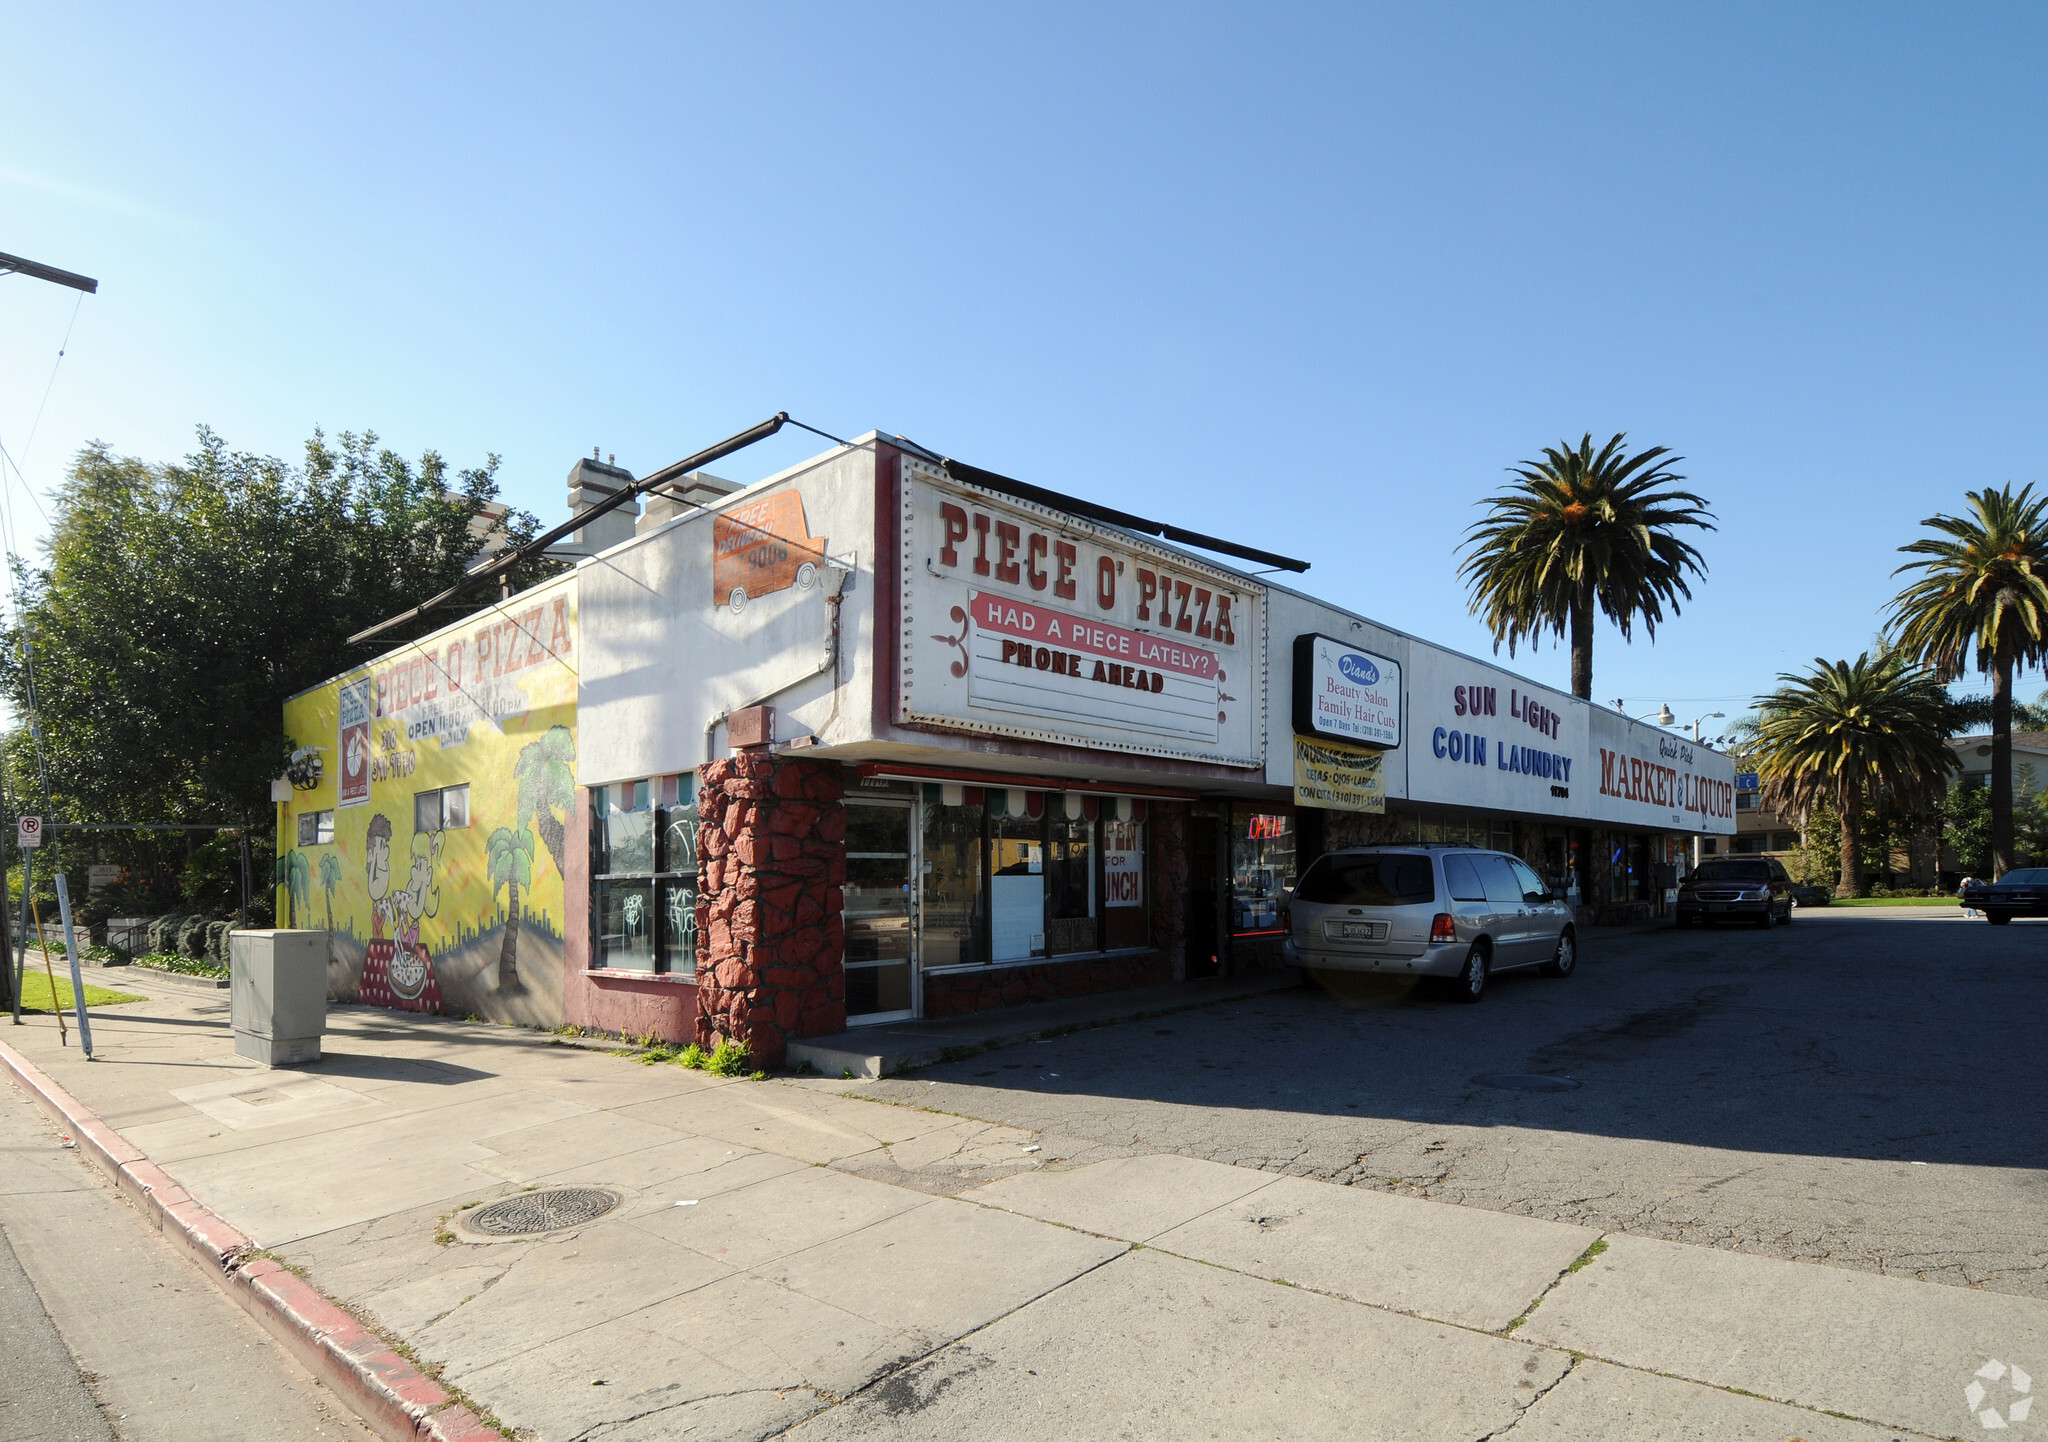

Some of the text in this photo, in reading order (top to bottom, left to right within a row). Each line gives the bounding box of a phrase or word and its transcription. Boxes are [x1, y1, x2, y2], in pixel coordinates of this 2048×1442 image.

[727, 502, 769, 534] FREE
[716, 521, 773, 556] DELIVERY
[939, 501, 1235, 646] PIECE O' PIZZA
[988, 603, 1210, 675] HAD A PIECE LATELY?
[376, 598, 571, 718] PIECE O' PIZZA
[1002, 640, 1164, 693] PHONE AHEAD
[1343, 656, 1376, 682] Diana's
[1327, 676, 1389, 707] Beauty Salon
[408, 717, 435, 738] OPEN
[439, 711, 461, 731] 11:00
[508, 699, 522, 713] PM
[422, 702, 444, 718] FREE
[1318, 695, 1395, 728] Family Hair Cuts
[1319, 716, 1332, 727] Open
[1334, 719, 1337, 728] 7
[1339, 720, 1350, 731] Days
[1454, 685, 1561, 740] SUN LIGHT
[382, 728, 396, 751] 310
[440, 728, 467, 746] DAILY
[1659, 736, 1678, 761] Quick
[1432, 726, 1487, 767] COIN
[1498, 741, 1573, 783] LAUNDRY
[1299, 786, 1316, 798] CON
[1306, 768, 1328, 783] CEJAS
[1333, 772, 1351, 786] OJOS
[1599, 748, 1676, 808] MARKET
[1684, 773, 1733, 819] LIQUOR
[1105, 822, 1136, 851] PEN
[1249, 817, 1282, 838] OPEN
[1105, 857, 1126, 867] FOR
[1105, 872, 1138, 902] UNCH
